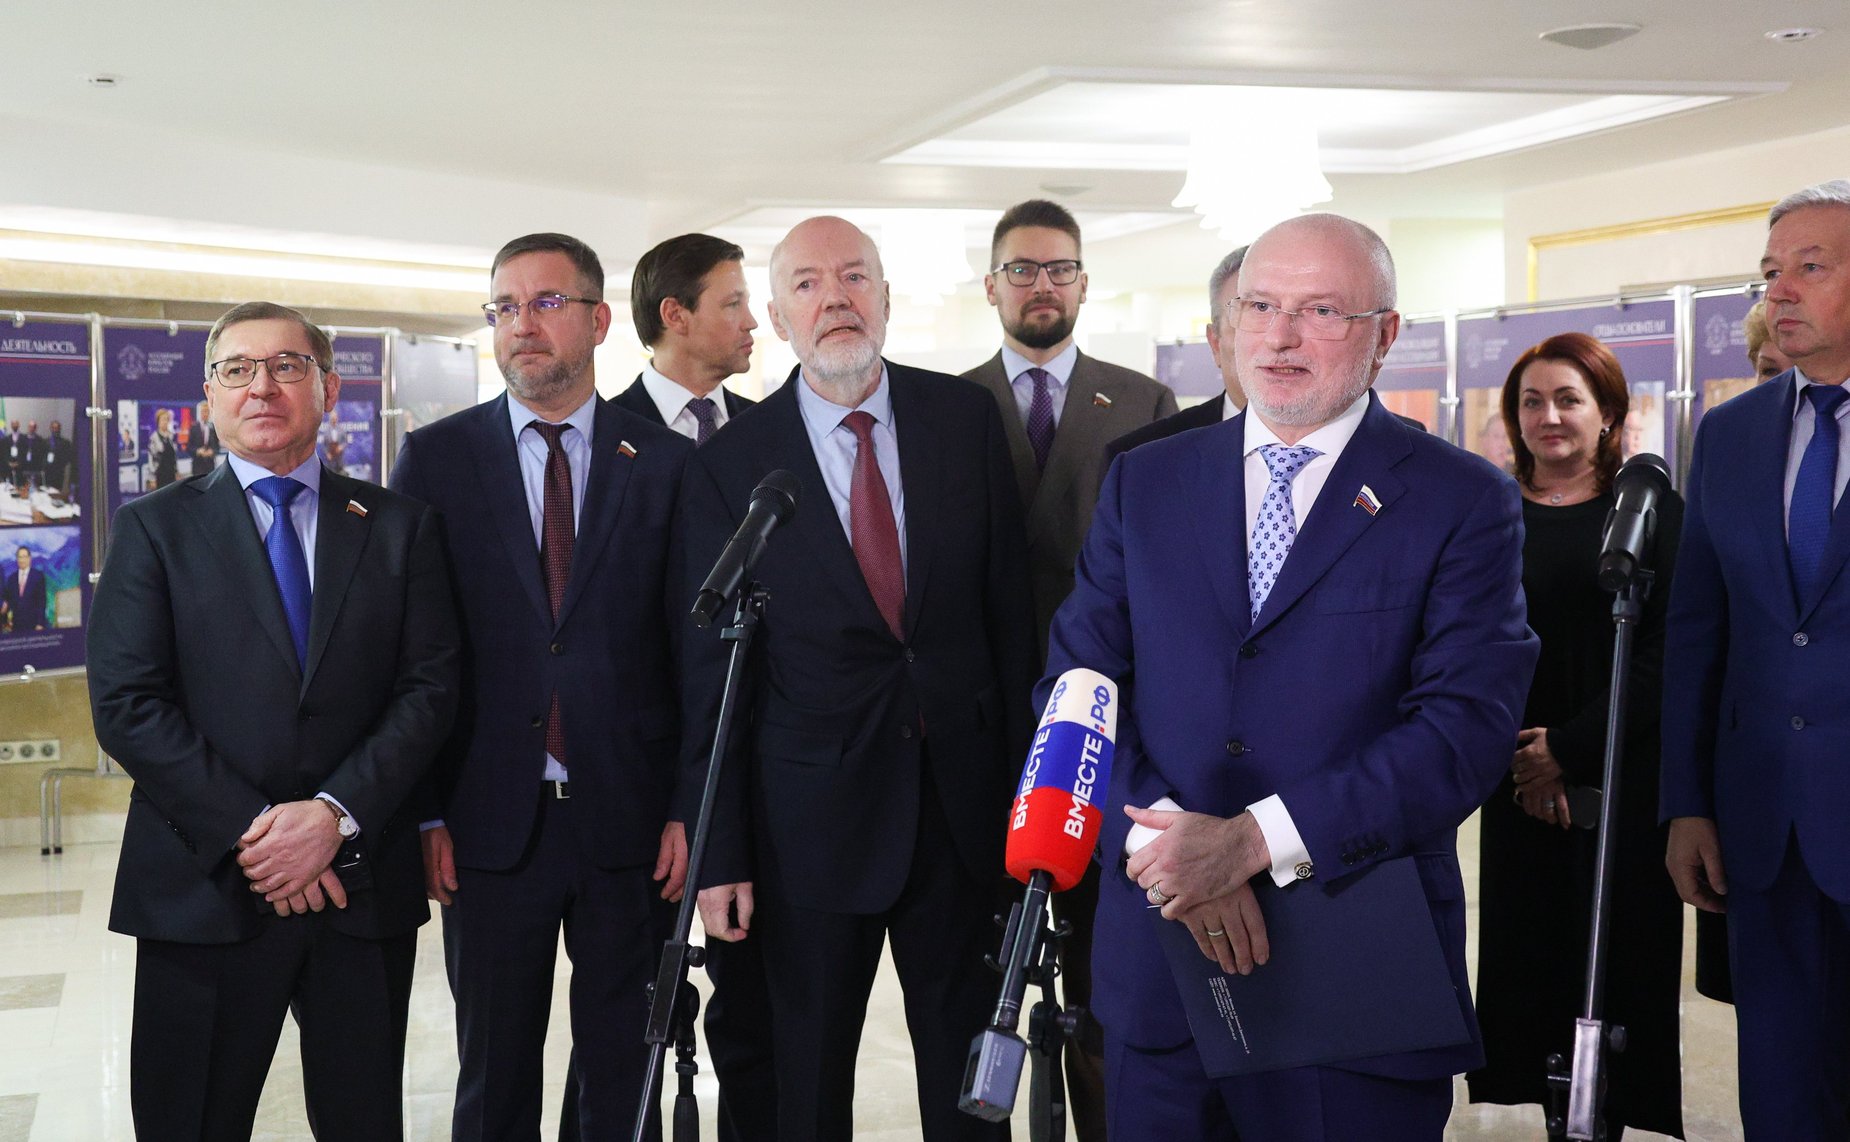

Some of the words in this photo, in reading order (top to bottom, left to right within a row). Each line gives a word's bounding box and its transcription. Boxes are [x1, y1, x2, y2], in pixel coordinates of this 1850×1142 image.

[1, 338, 77, 354] ДЕЯТЕЛЬНОСТЬ
[1013, 680, 1067, 831] ВМЕСТЕ:РФ
[1064, 685, 1111, 839] ВМЕСТЕ:РФ
